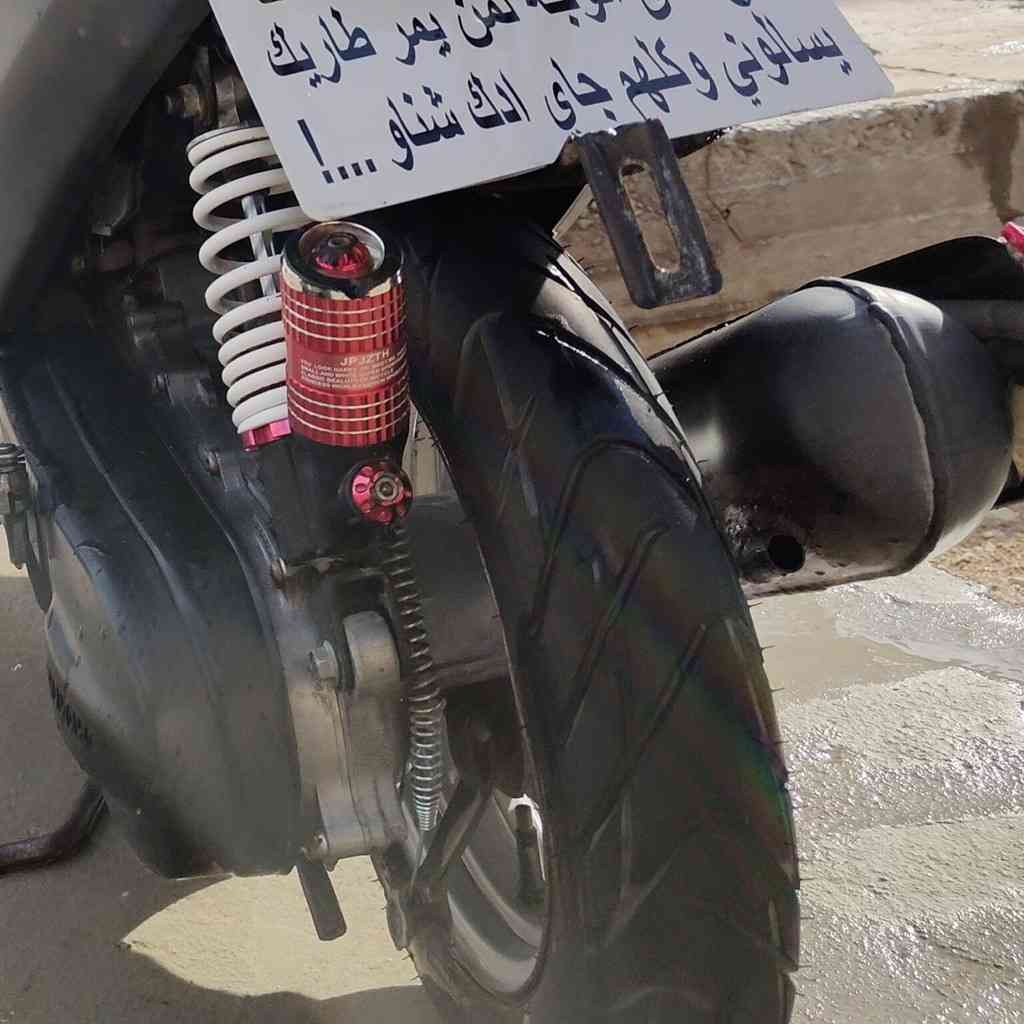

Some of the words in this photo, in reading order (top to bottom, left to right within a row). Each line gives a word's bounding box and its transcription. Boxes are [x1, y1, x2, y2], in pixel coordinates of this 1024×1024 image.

[266, 6, 377, 88] طاريك
[395, 10, 452, 65] يمر
[387, 83, 466, 171] شناو
[466, 70, 531, 130] ادك
